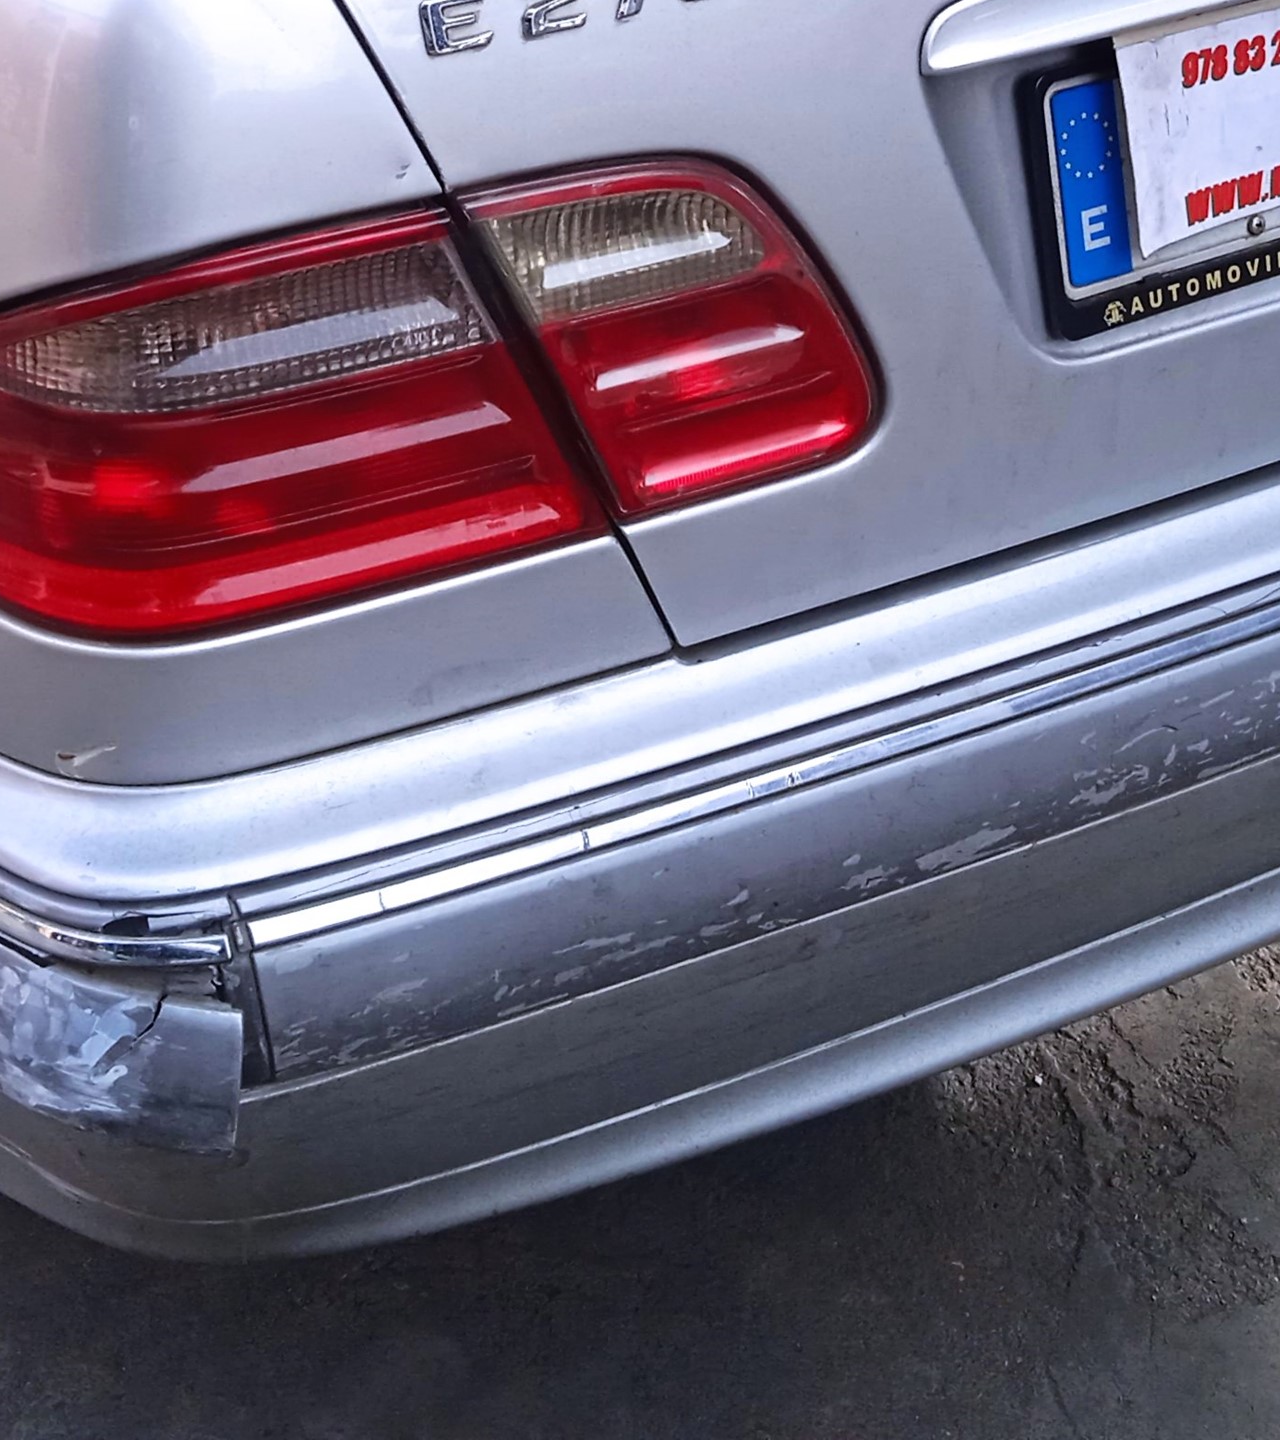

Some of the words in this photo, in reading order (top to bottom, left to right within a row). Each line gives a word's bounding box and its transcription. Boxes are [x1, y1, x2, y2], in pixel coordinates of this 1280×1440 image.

[1181, 40, 1226, 88] 978
[1234, 34, 1266, 76] 83
[1081, 204, 1111, 252] E
